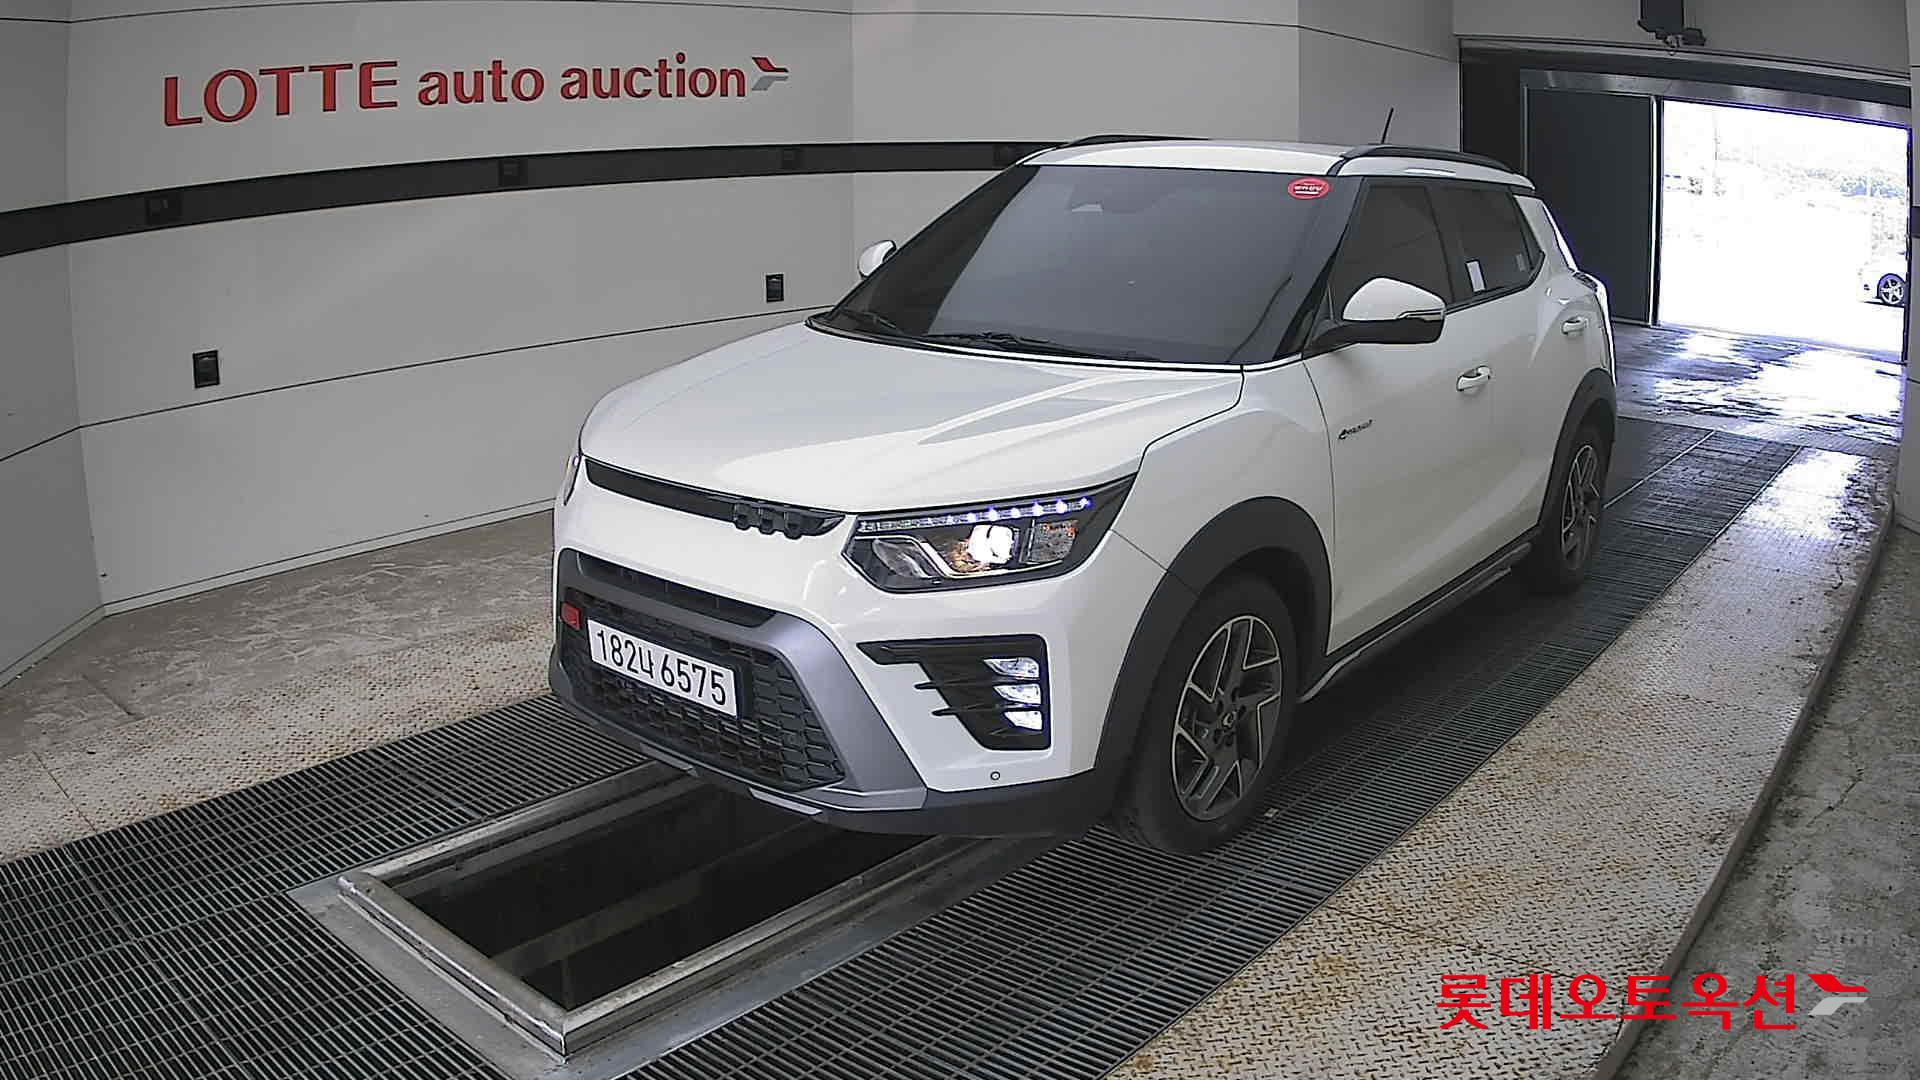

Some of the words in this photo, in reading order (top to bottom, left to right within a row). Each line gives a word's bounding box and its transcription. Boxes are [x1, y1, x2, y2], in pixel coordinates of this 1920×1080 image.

[164, 60, 398, 127] LOTTE
[417, 58, 545, 106] auto
[559, 52, 747, 100] auction
[597, 630, 654, 679] 182나
[660, 653, 726, 706] 6575
